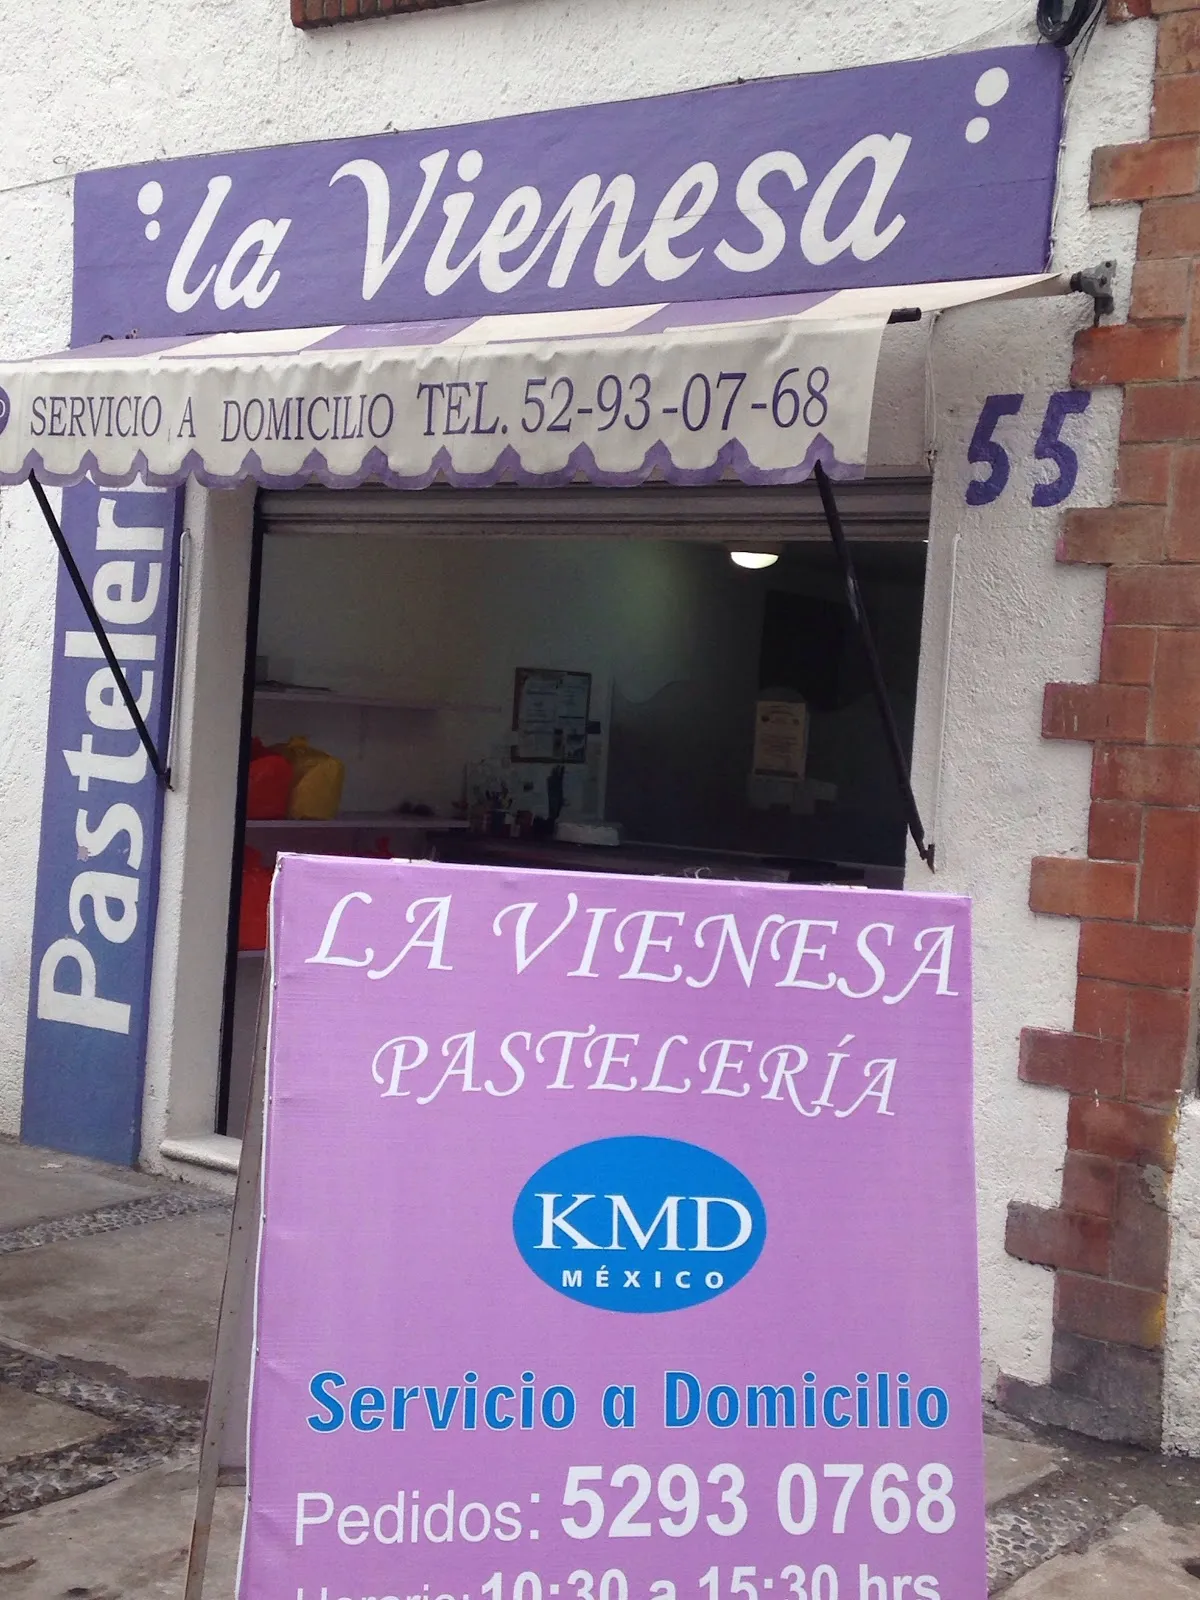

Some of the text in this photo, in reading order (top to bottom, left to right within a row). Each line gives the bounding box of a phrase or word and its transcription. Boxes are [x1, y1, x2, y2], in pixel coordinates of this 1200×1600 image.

[166, 132, 912, 313] la Vienesa
[31, 367, 829, 442] SERVICIO A DOMICILIO TEL. 52-93-07-68
[965, 391, 1091, 507] 55
[304, 891, 959, 1004] LA VIENESA
[371, 1024, 898, 1118] PASTELERÍA
[533, 1193, 753, 1252] KMD
[562, 1264, 724, 1289] MÉXICO
[307, 1370, 950, 1434] Servicio a Domicilio
[295, 1462, 956, 1546] Pedidos: 5293 0768
